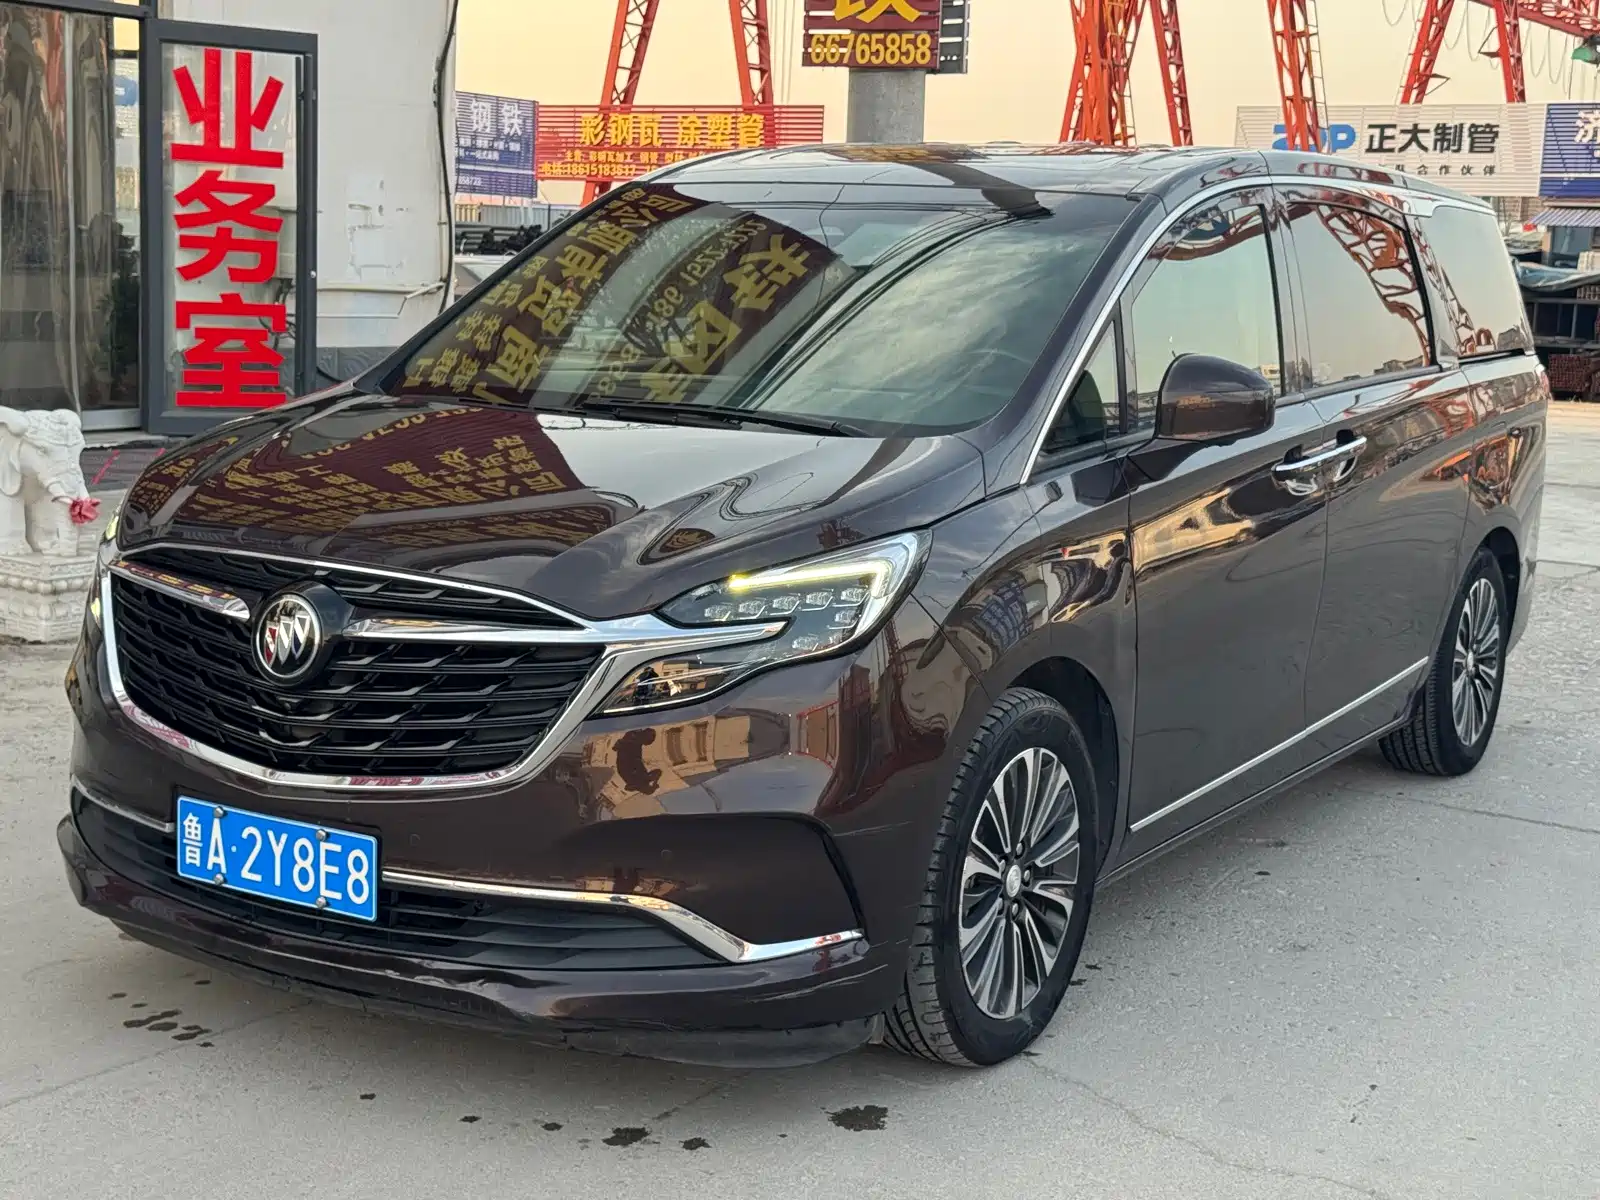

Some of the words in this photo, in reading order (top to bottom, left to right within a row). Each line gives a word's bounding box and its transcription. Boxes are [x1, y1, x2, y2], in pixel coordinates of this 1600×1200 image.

[810, 33, 932, 65] 66765858
[579, 112, 663, 148] 彩钢瓦
[677, 112, 765, 149] 涂塑管
[1365, 123, 1499, 154] 正大制管
[171, 48, 287, 408] 业务室
[182, 812, 370, 905] 鲁A·2Y8E8
